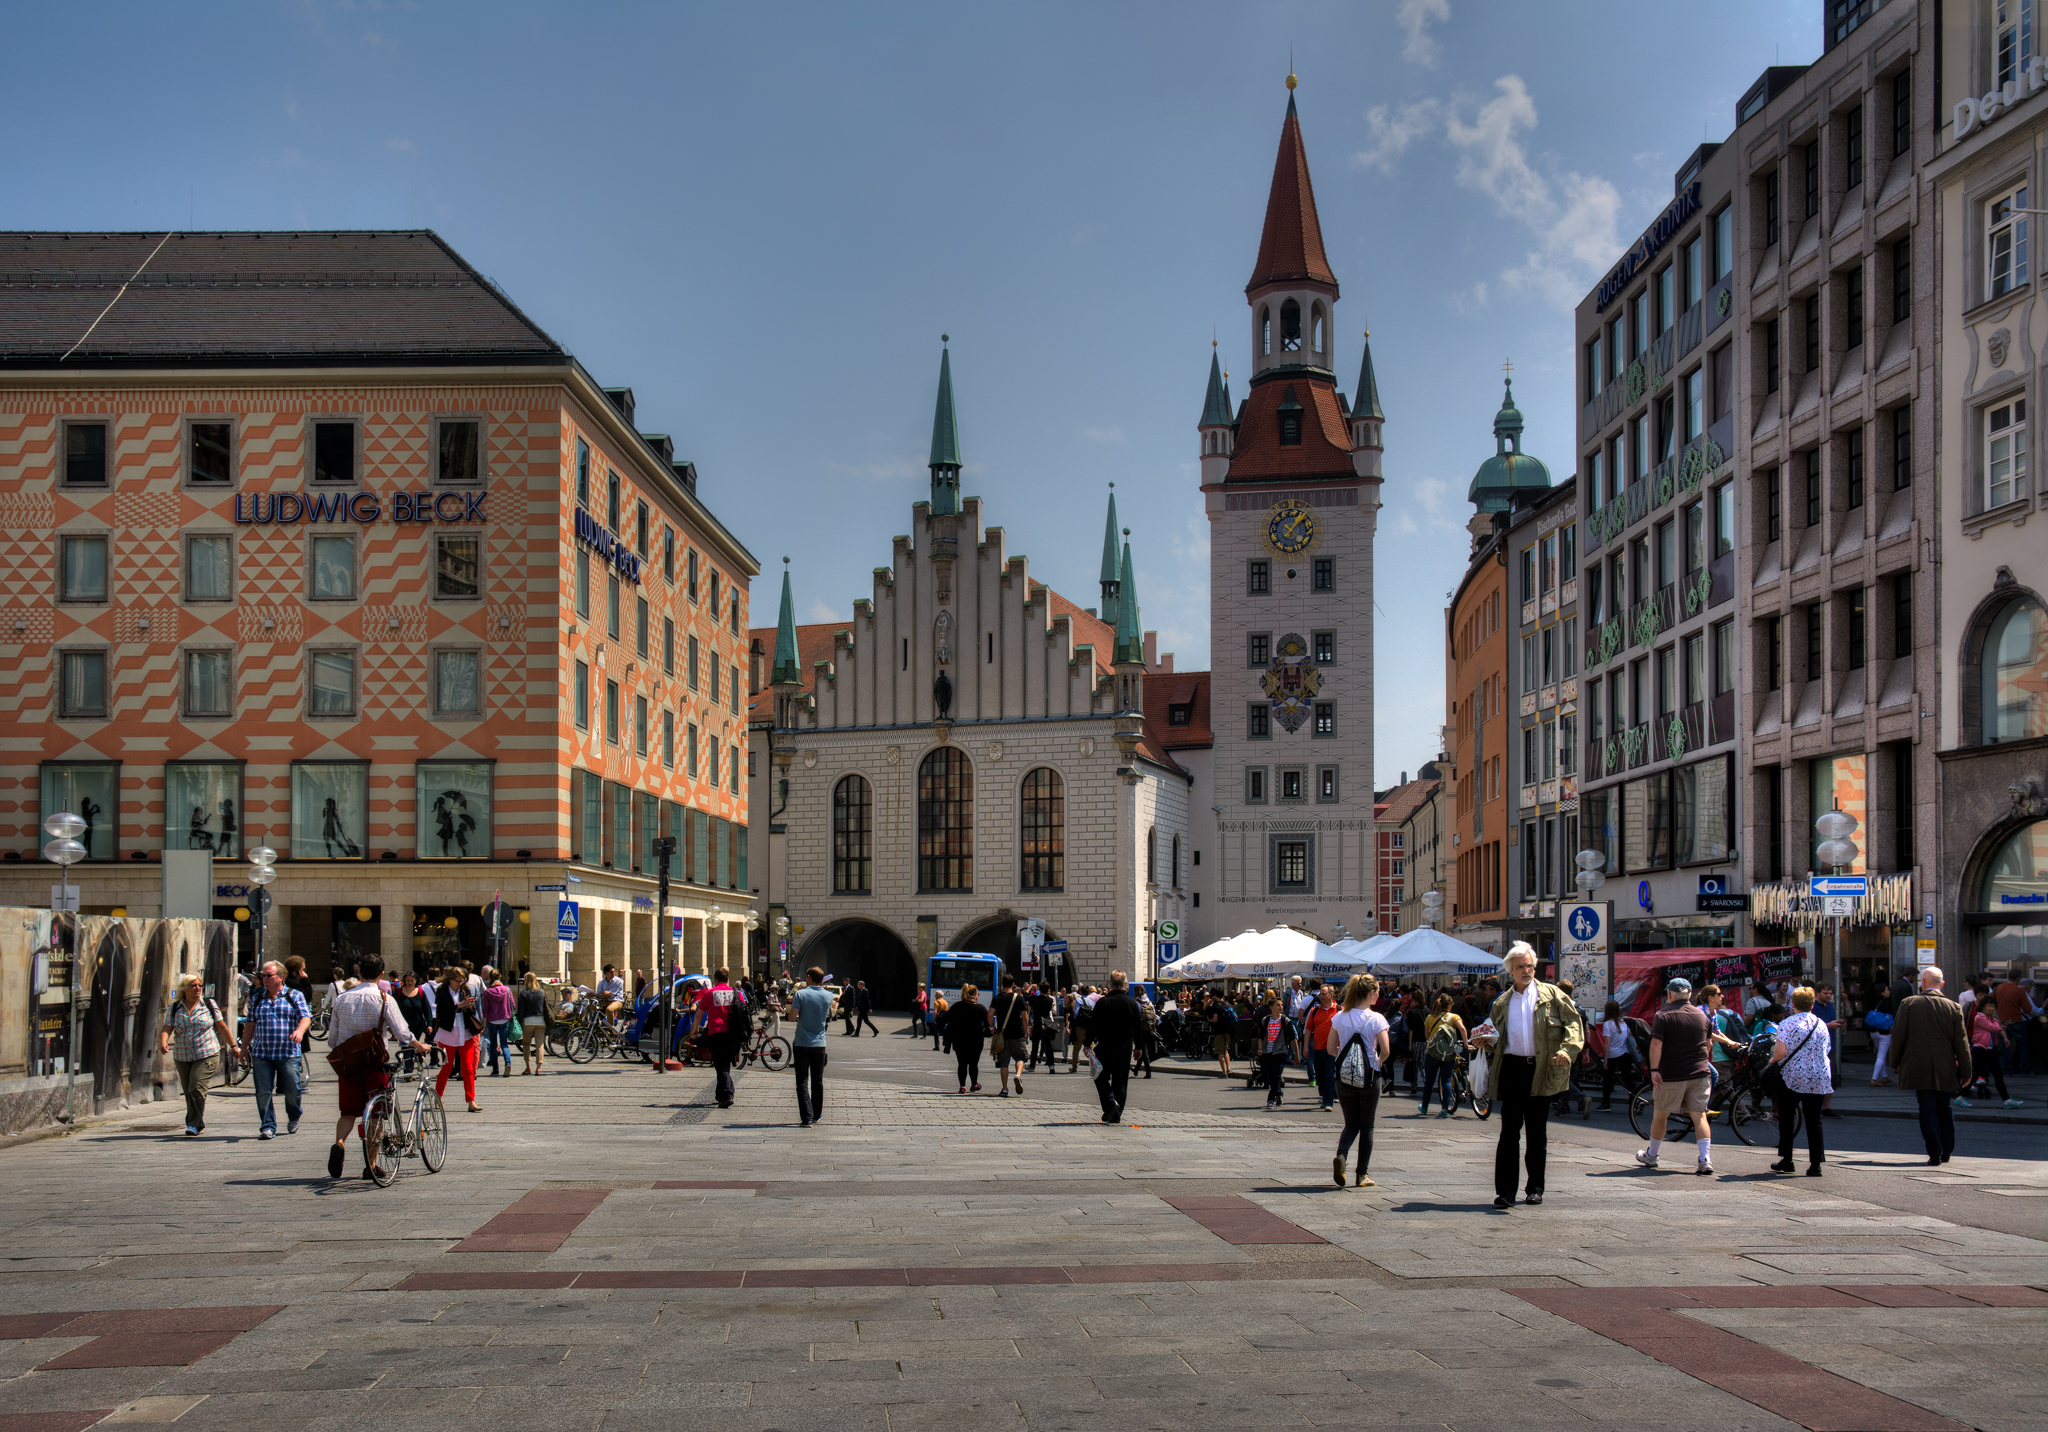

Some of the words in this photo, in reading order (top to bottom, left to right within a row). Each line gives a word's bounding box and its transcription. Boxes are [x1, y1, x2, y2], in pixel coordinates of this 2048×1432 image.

[1596, 254, 1636, 313] AUGEN
[1652, 182, 1702, 251] KLINIK
[235, 492, 381, 523] LUDWIG
[393, 491, 487, 522] BECK
[575, 507, 615, 562] LUDWIG
[615, 543, 641, 585] BECK
[216, 885, 250, 897] BECK
[2001, 893, 2044, 904] Deutsche
[1161, 921, 1177, 939] S
[1160, 945, 1177, 962] U
[1253, 964, 1274, 973] Café
[1312, 963, 1352, 973] Rischart
[1400, 964, 1420, 973] Café
[1457, 963, 1498, 974] Rischart
